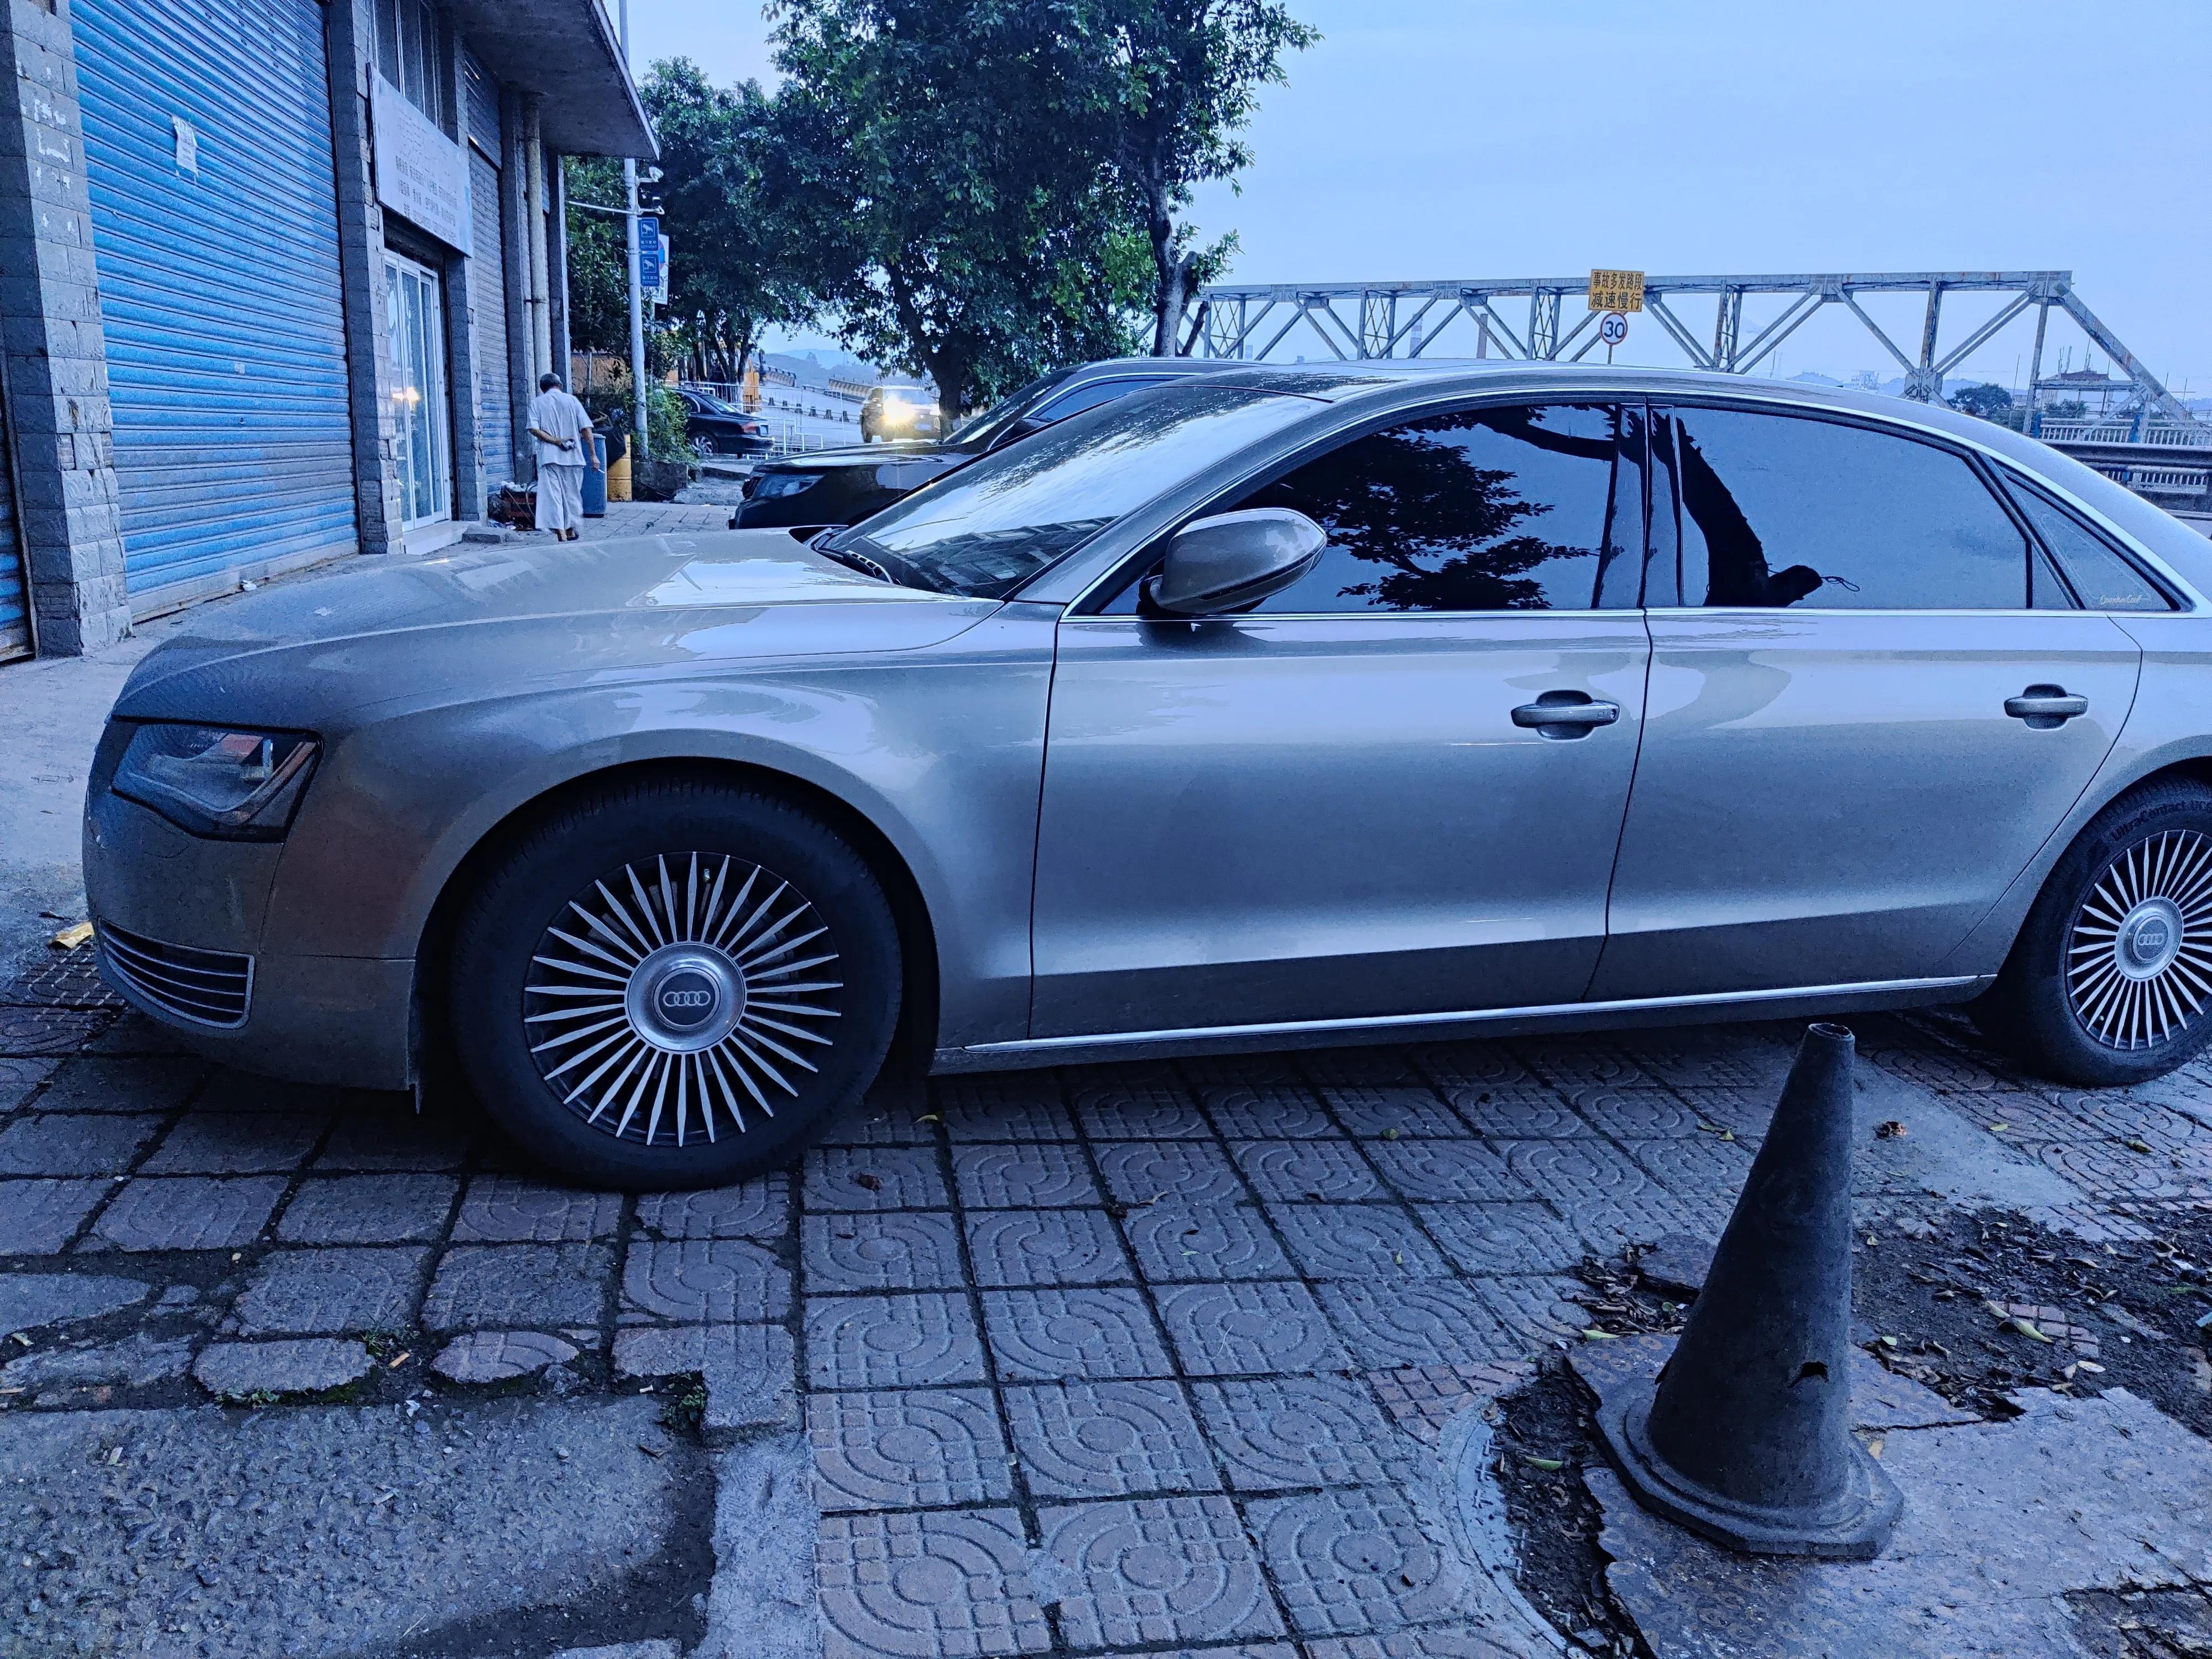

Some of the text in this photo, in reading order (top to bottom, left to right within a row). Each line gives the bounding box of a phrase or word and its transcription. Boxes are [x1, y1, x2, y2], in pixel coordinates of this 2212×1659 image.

[1593, 271, 1642, 291] 事故多发路段
[1591, 290, 1642, 310] 减速慢行
[1604, 321, 1625, 338] 30
